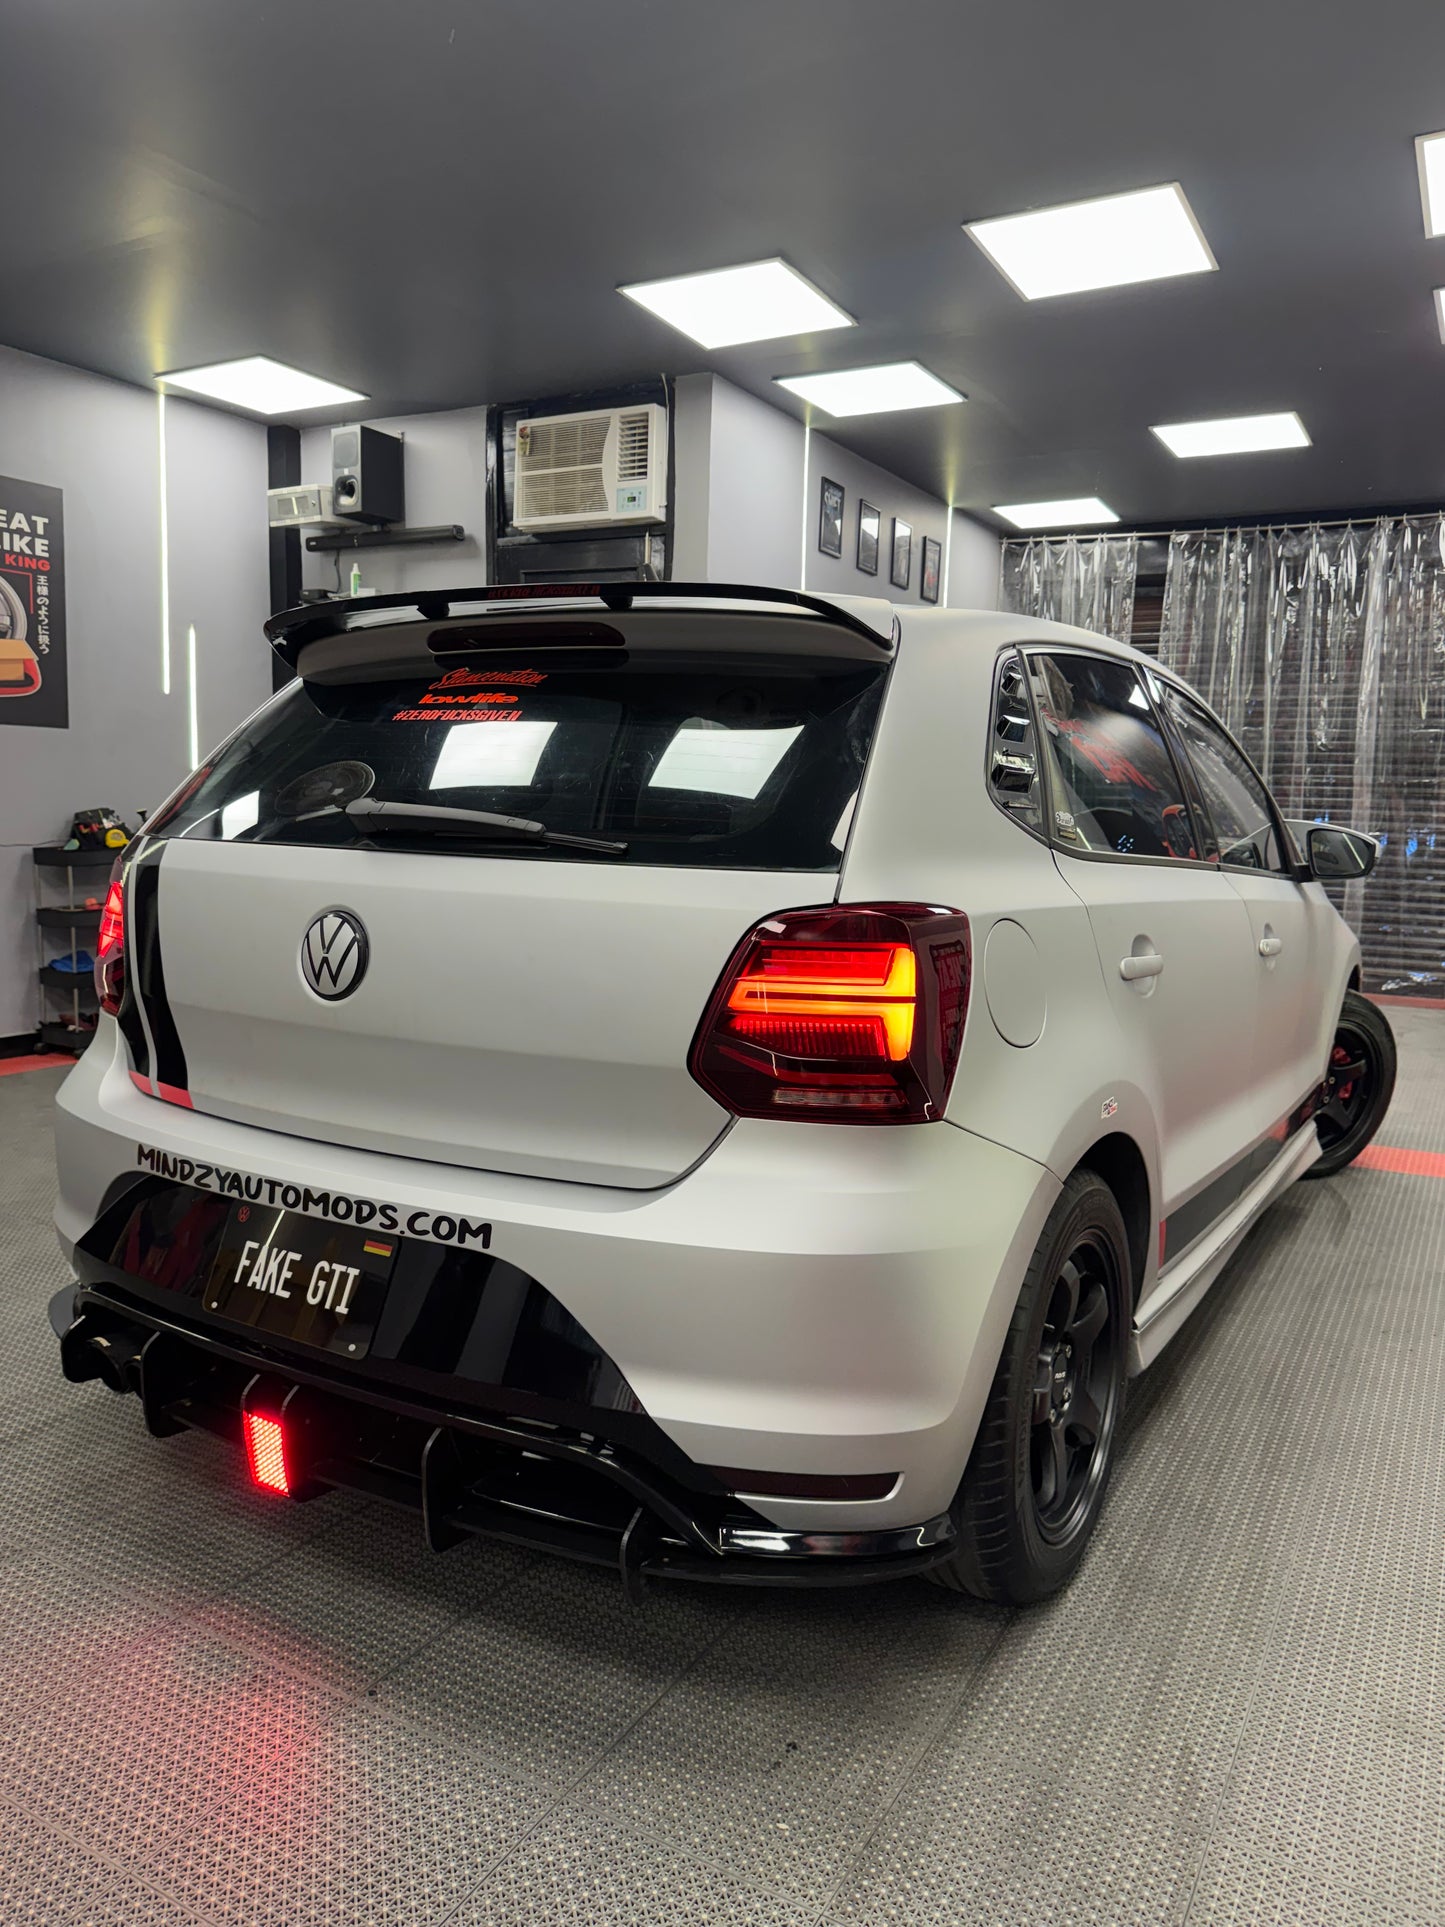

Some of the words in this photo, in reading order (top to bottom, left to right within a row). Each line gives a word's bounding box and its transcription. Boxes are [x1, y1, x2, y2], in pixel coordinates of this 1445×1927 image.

[0, 531, 50, 558] IKE
[4, 553, 51, 571] KING
[418, 692, 519, 704] lowlife
[392, 709, 523, 721] #ZEROFUCKSGIVEN
[137, 1143, 493, 1250] MINDZYAUTOMODS.COM
[233, 1240, 302, 1299] FAKE
[306, 1260, 360, 1315] GTI
